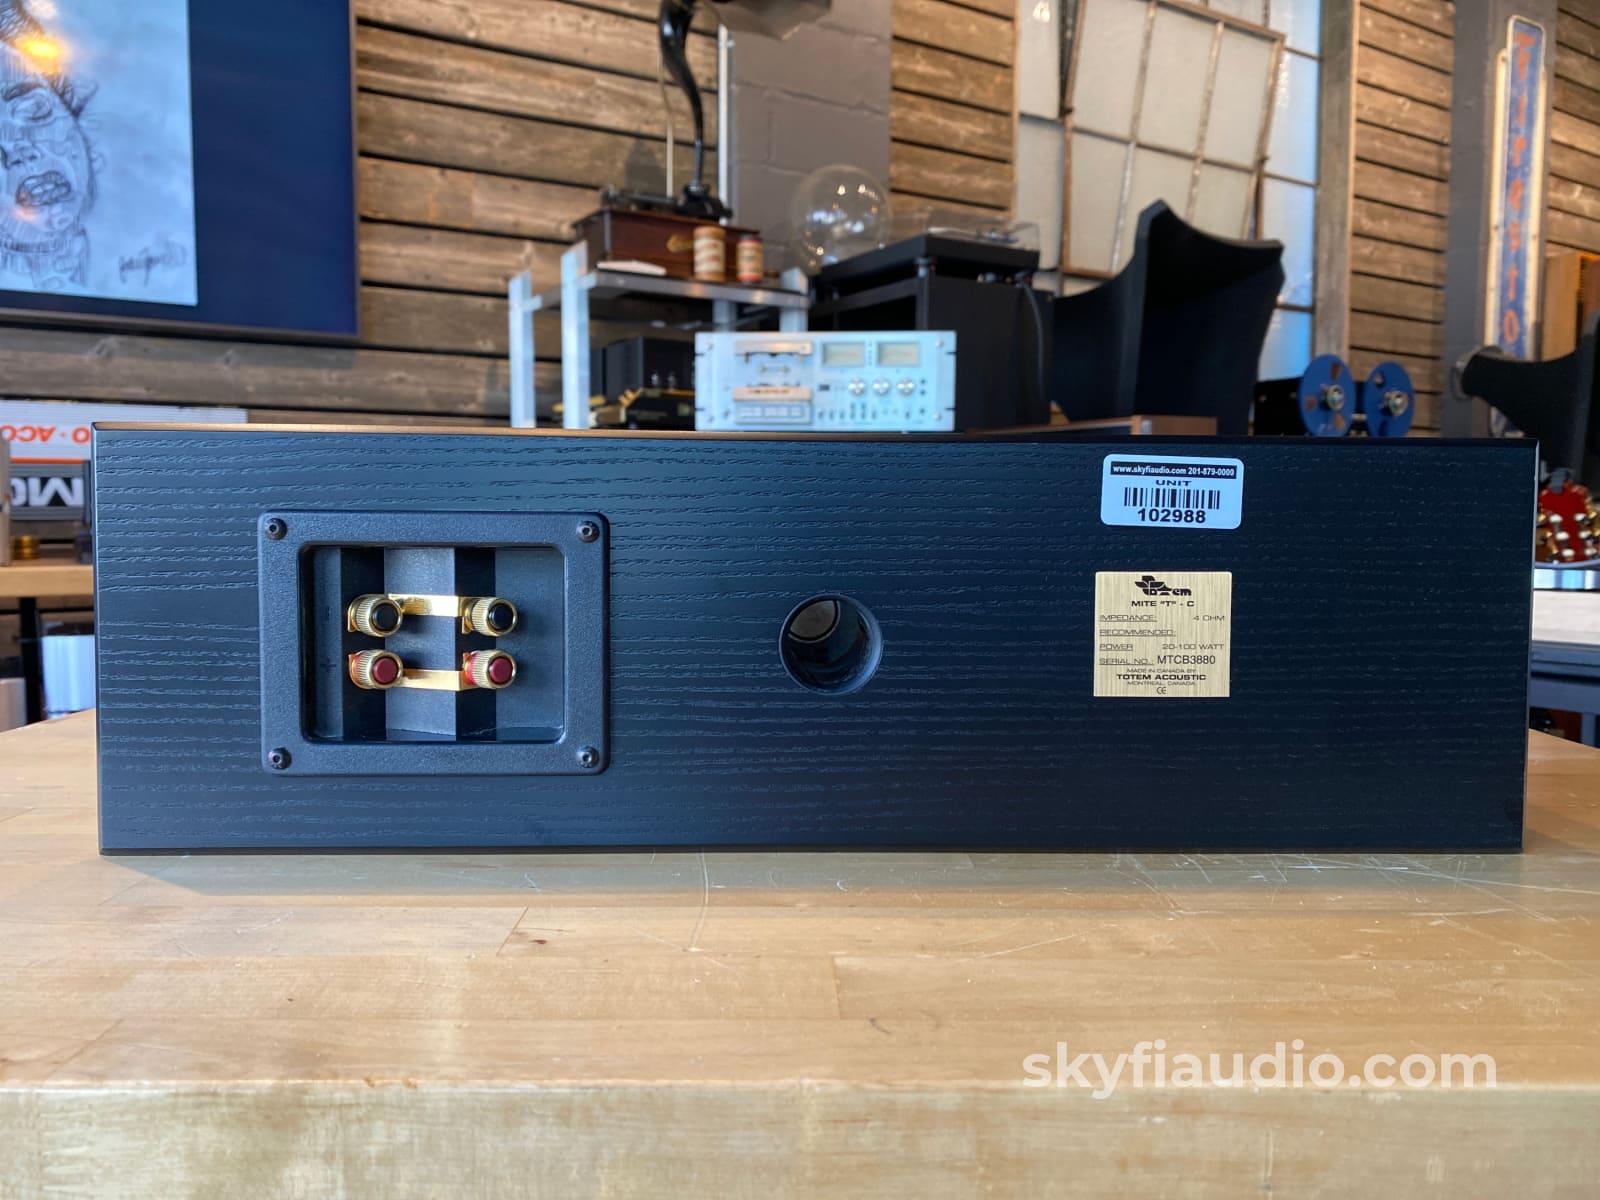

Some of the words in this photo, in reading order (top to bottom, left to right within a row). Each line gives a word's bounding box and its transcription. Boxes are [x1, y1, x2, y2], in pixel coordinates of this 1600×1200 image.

[1112, 464, 1187, 476] www.skyfiaudio.com
[1188, 466, 1235, 477] 201-879-0000
[1155, 479, 1192, 487] UNIT
[1137, 508, 1207, 524] 102988
[1157, 655, 1216, 665] MTCB3880
